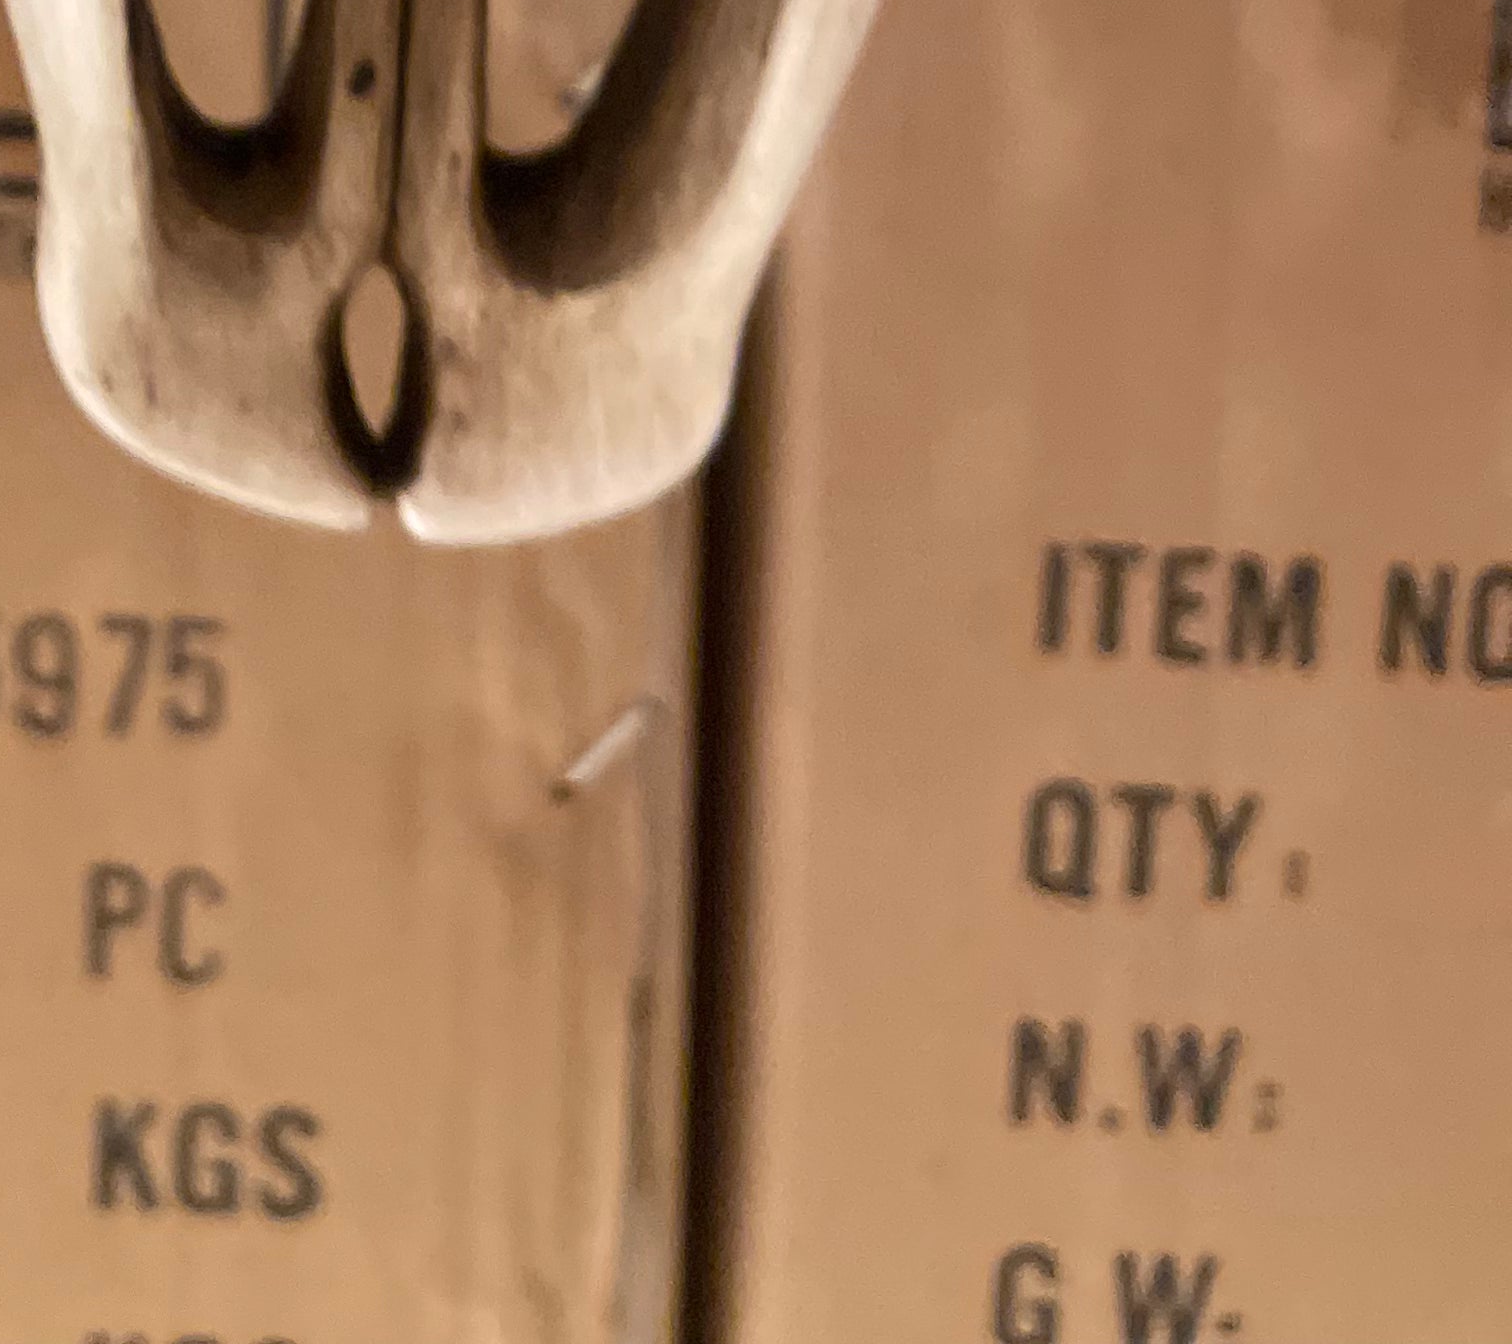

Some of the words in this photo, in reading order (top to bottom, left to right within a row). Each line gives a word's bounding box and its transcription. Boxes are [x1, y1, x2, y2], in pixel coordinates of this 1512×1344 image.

[1036, 540, 1325, 670] ITEM
[83, 858, 227, 988] PC
[1007, 1013, 1284, 1134] N.W:
[91, 1099, 325, 1223] KGS
